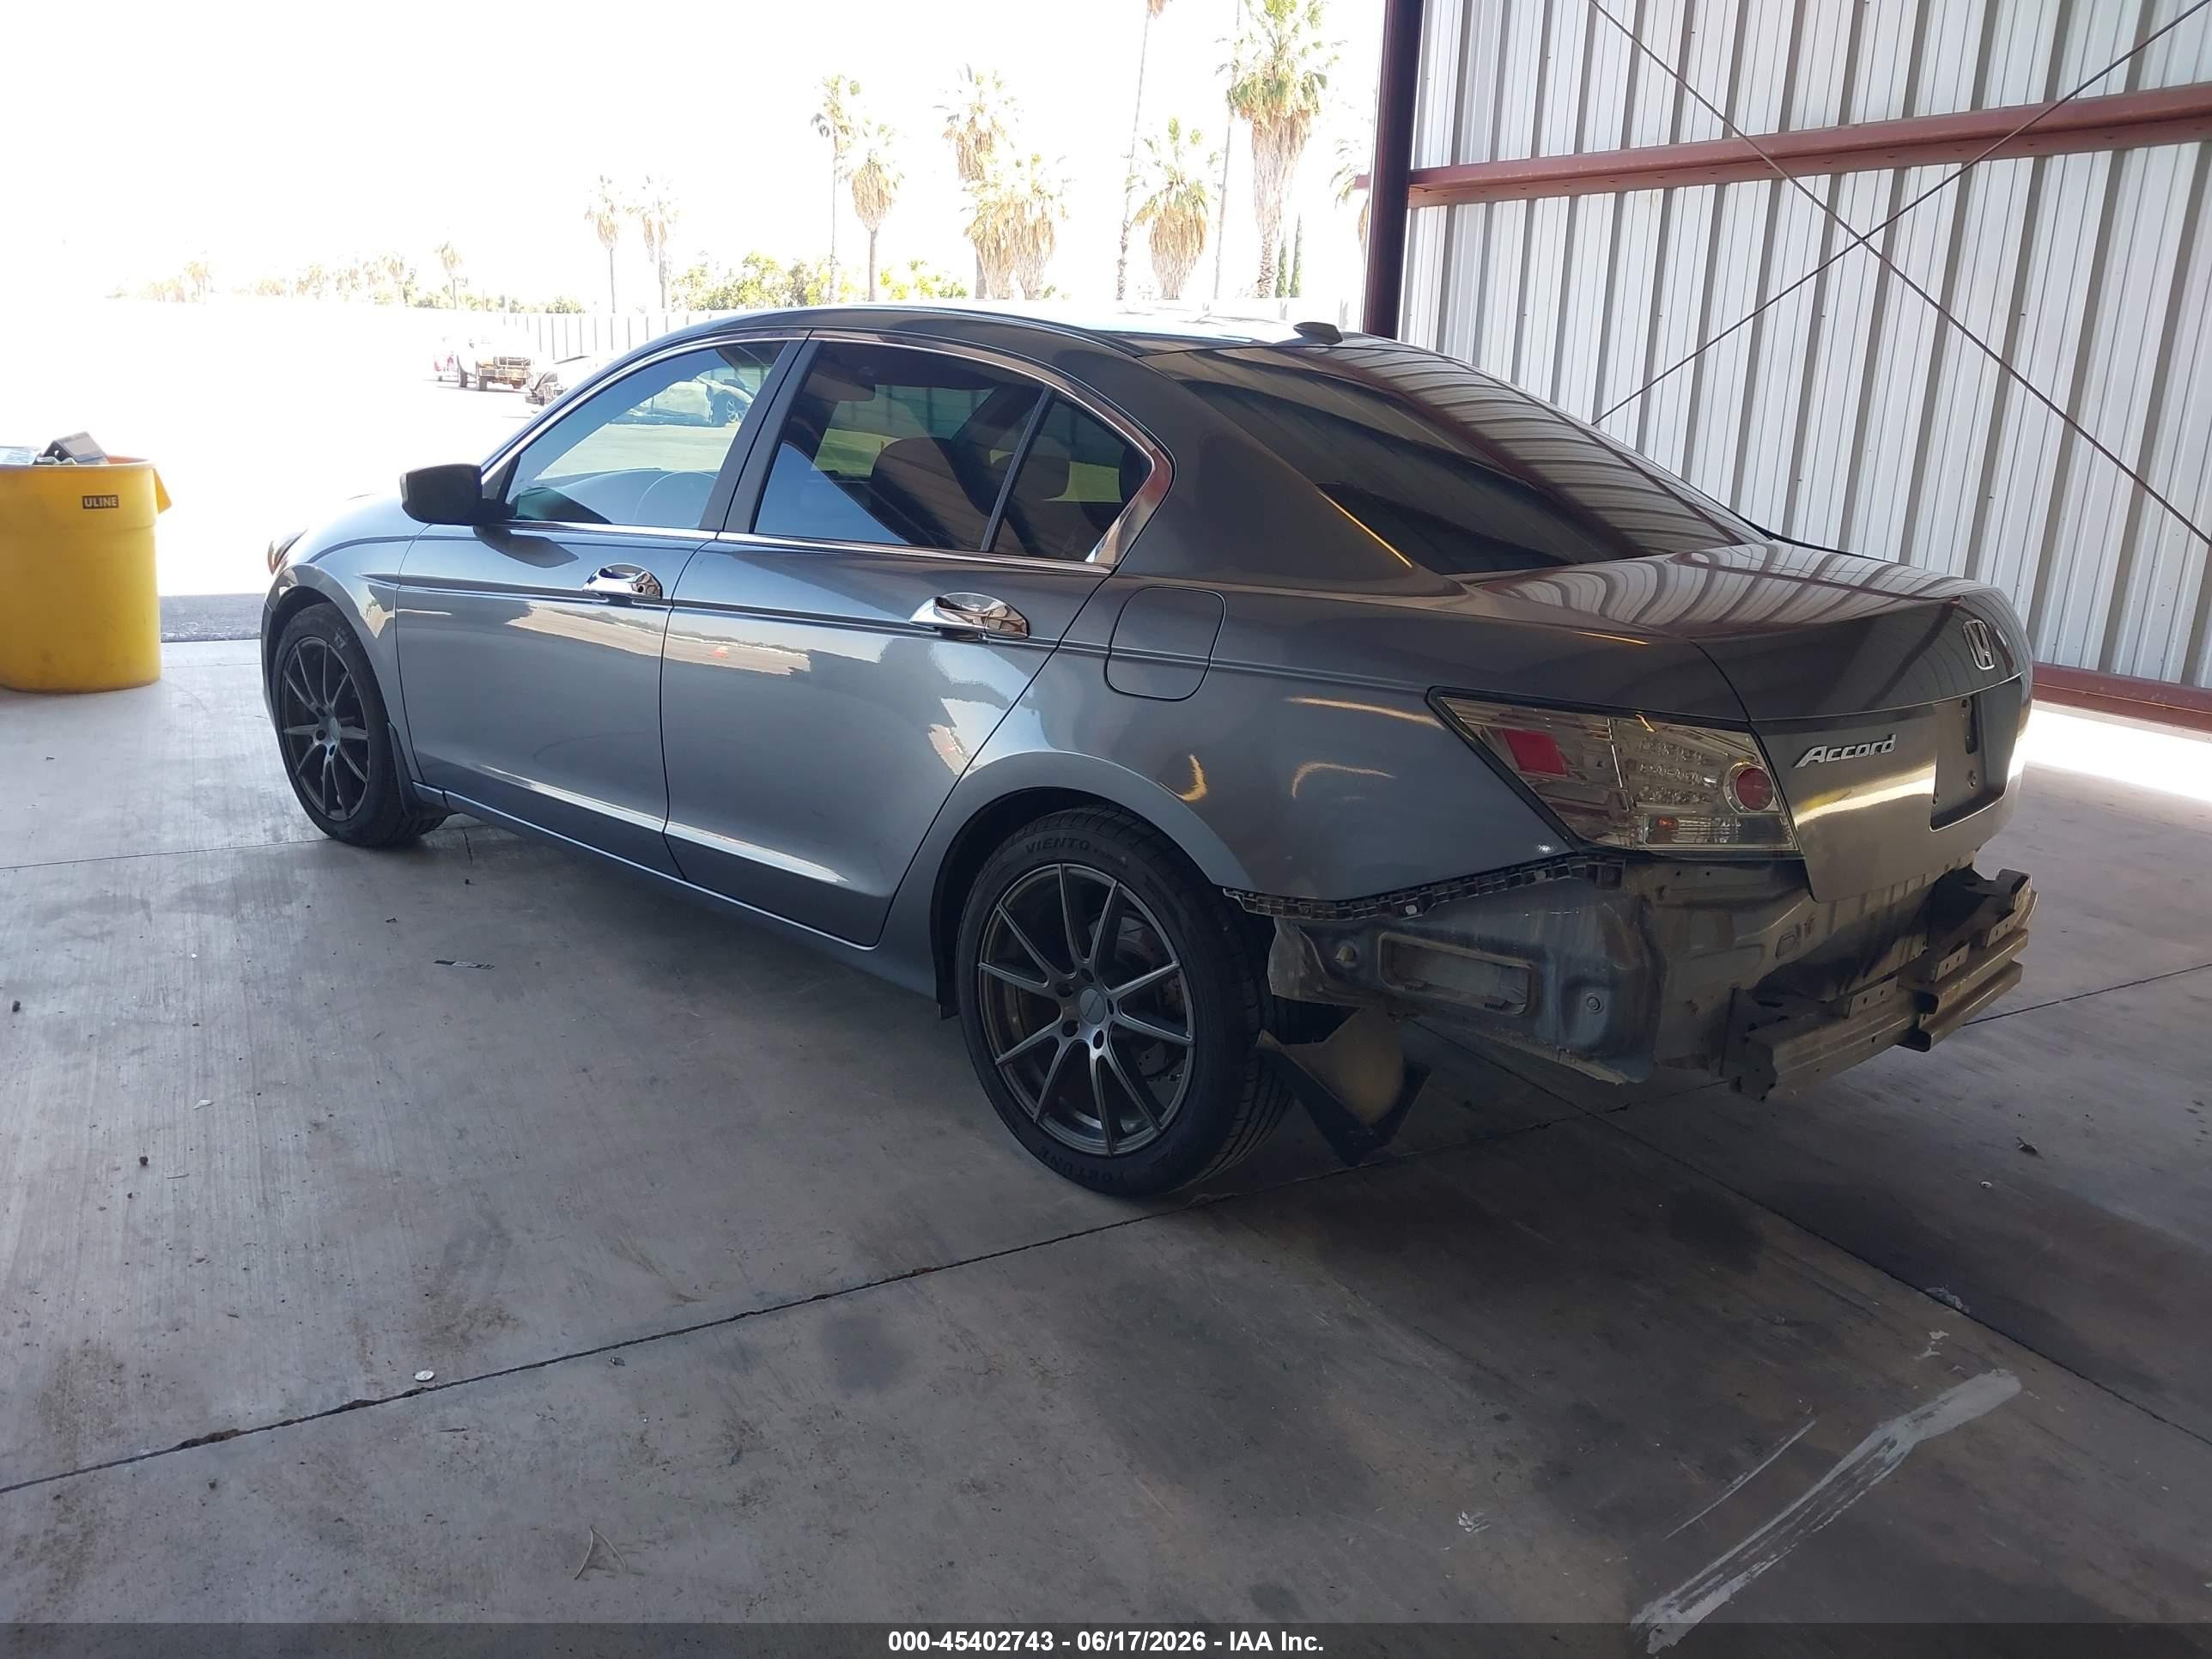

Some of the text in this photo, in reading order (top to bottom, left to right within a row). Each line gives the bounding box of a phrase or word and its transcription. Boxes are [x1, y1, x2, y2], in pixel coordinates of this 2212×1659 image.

[84, 496, 118, 507] ULINE
[1793, 733, 1897, 769] Accord
[1024, 836, 1091, 854] VIENTO
